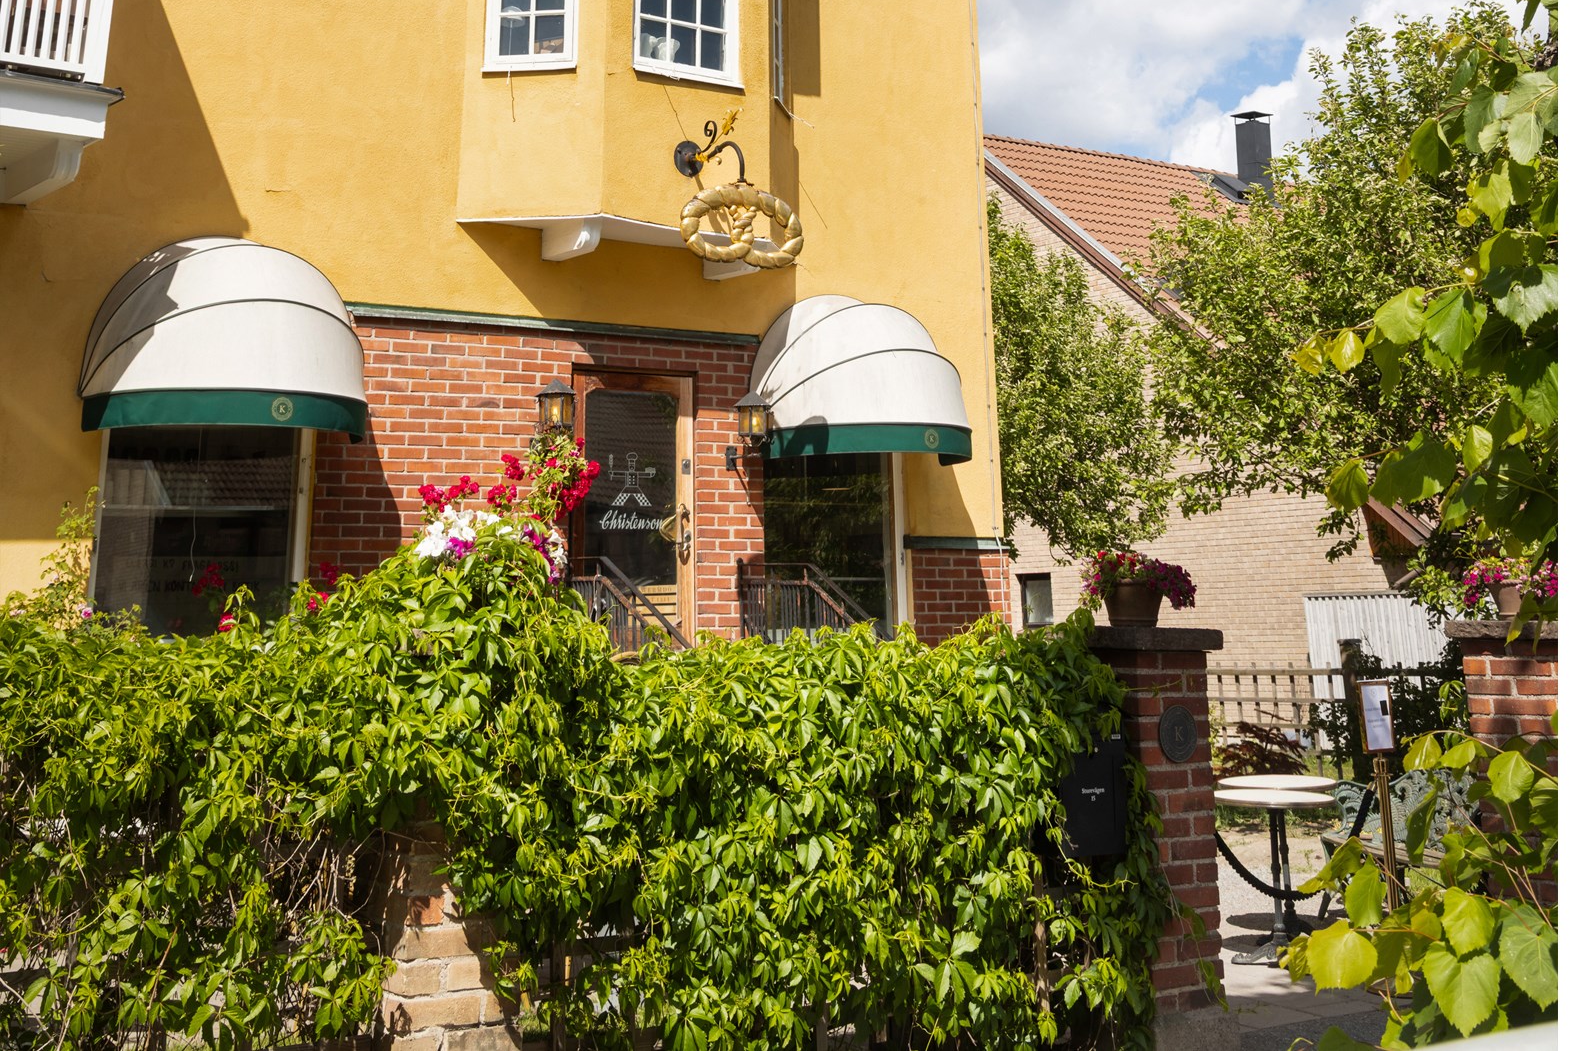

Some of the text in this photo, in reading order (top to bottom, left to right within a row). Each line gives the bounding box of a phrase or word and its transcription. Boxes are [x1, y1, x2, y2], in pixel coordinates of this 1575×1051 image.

[279, 405, 286, 413] K
[599, 510, 662, 529] Christenson
[1174, 726, 1183, 742] K
